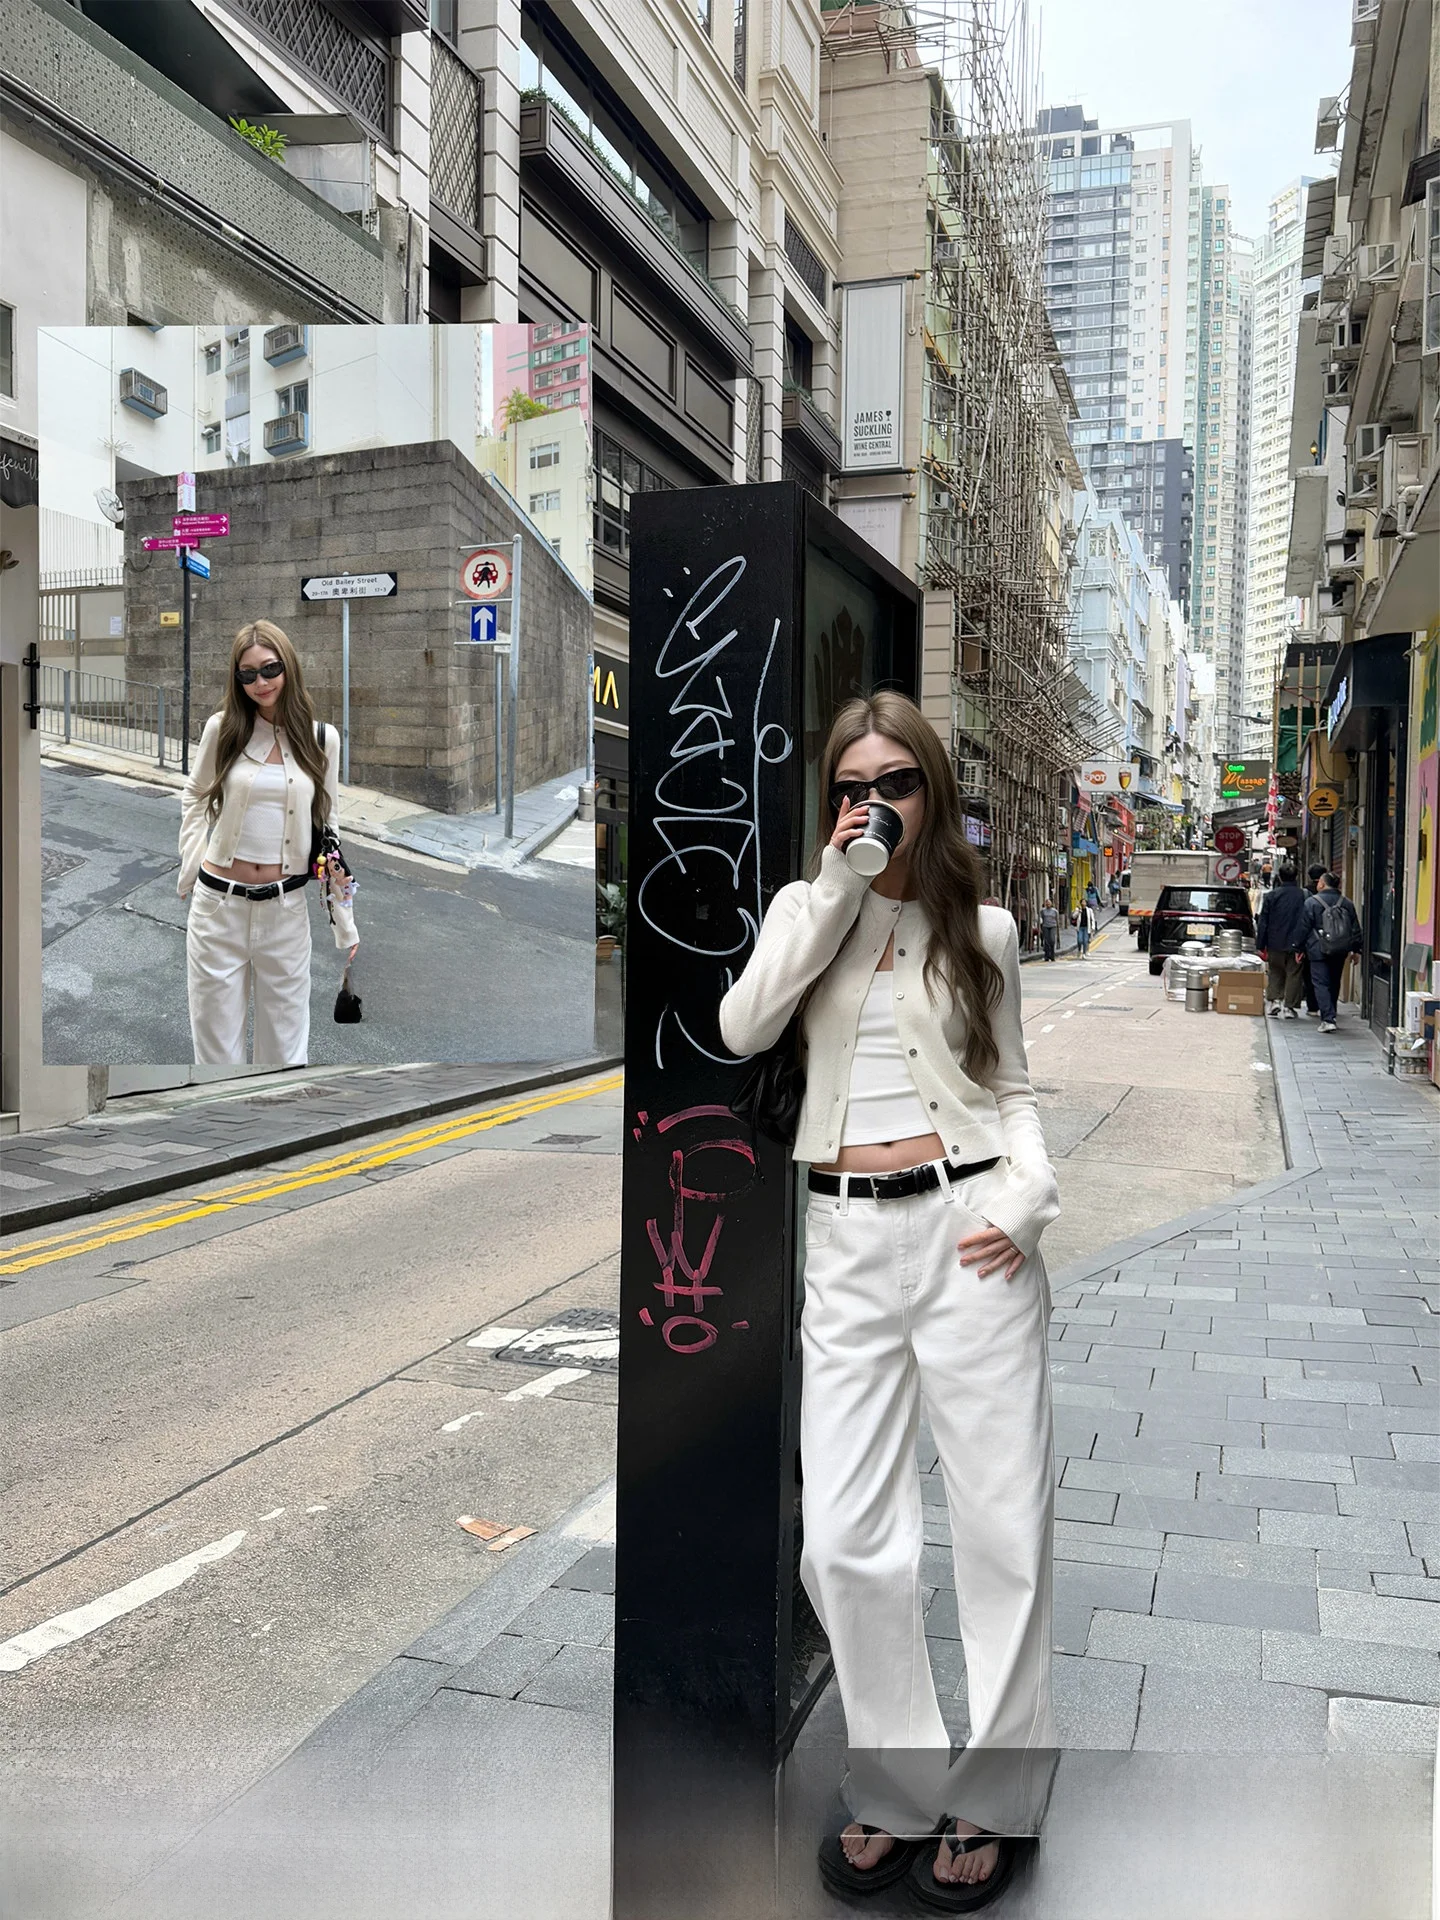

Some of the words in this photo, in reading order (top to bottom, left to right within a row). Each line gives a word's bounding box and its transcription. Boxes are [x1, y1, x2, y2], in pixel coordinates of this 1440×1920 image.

[854, 411, 883, 423] JAMES
[853, 423, 892, 437] SUCKLING
[853, 442, 868, 451] WINE
[868, 440, 892, 450] CENTRAL
[335, 578, 355, 586] Bailey
[357, 576, 378, 584] Street
[332, 586, 367, 596] 奧卑利街
[1083, 773, 1107, 782] SPOT
[1222, 762, 1267, 791] Massage
[1218, 831, 1241, 840] STOP
